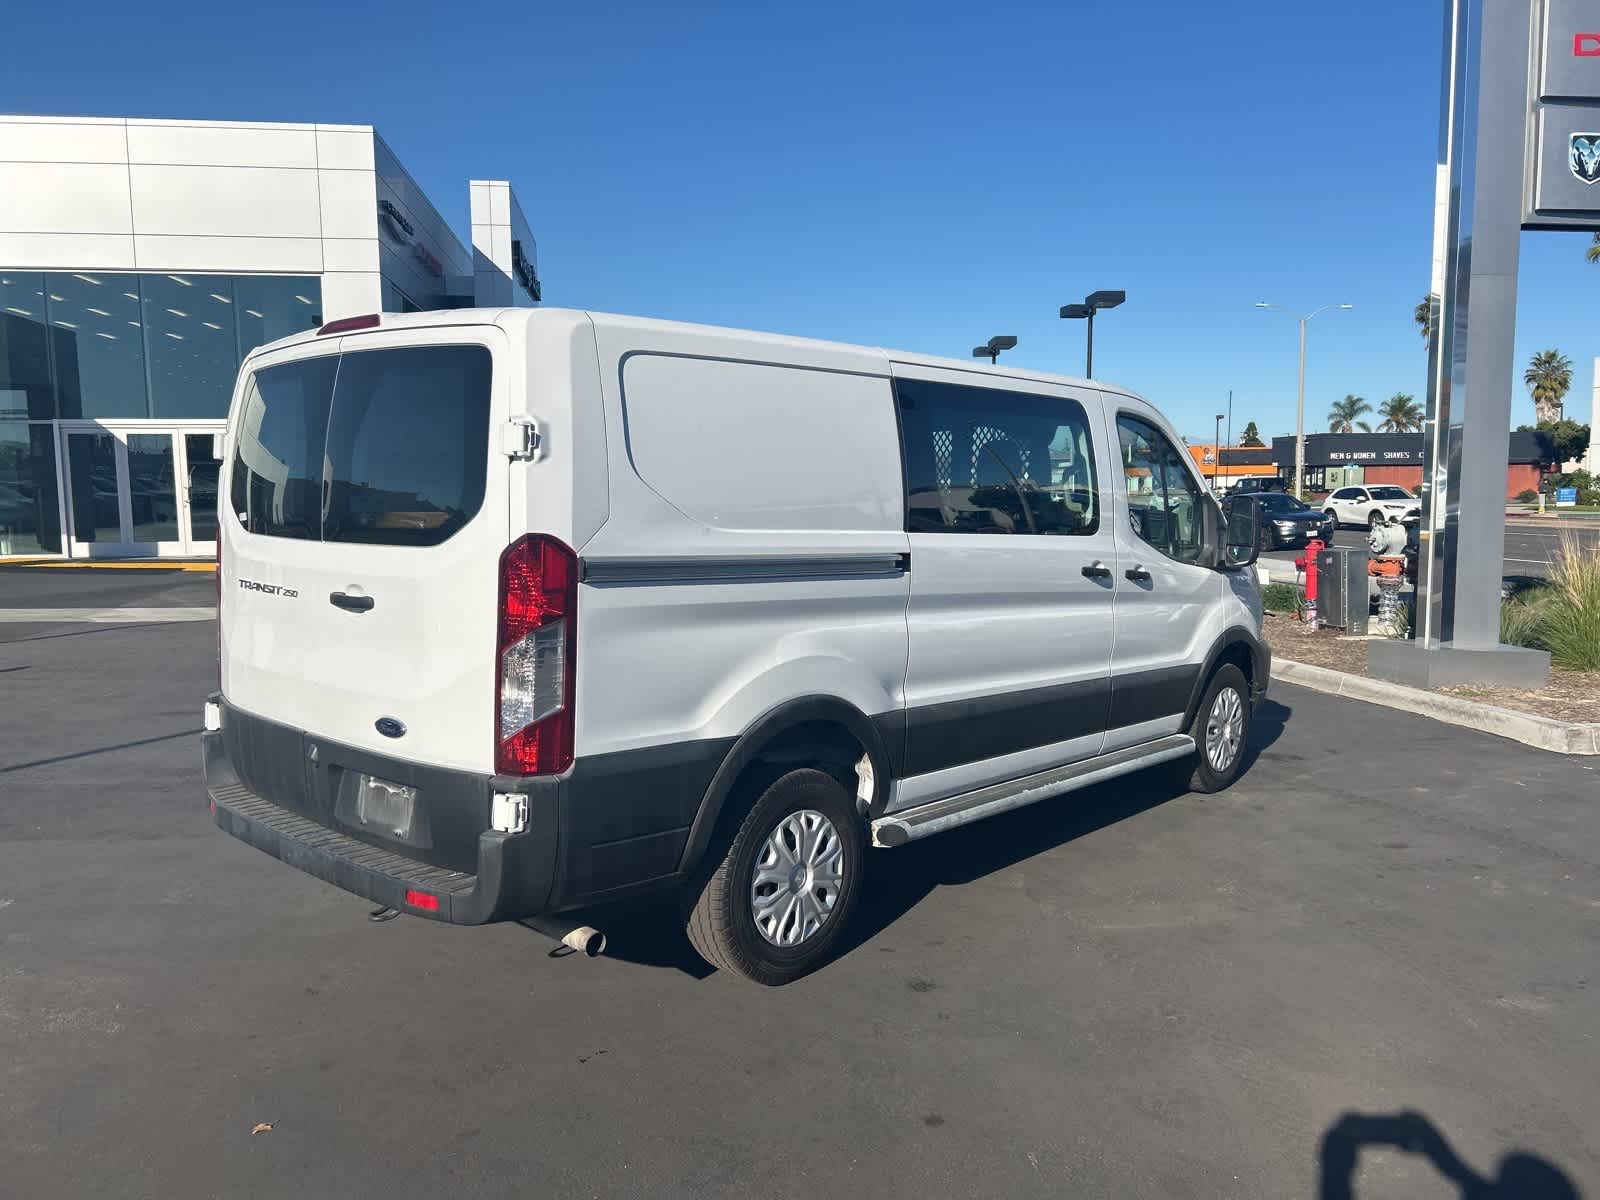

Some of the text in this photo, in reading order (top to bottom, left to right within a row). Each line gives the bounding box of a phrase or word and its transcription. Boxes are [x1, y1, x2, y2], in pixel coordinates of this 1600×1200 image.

[1330, 452, 1345, 460] MEN
[1353, 452, 1376, 460] WOMEN
[1383, 451, 1410, 459] SHAVES
[238, 579, 298, 598] TRANSIT 250
